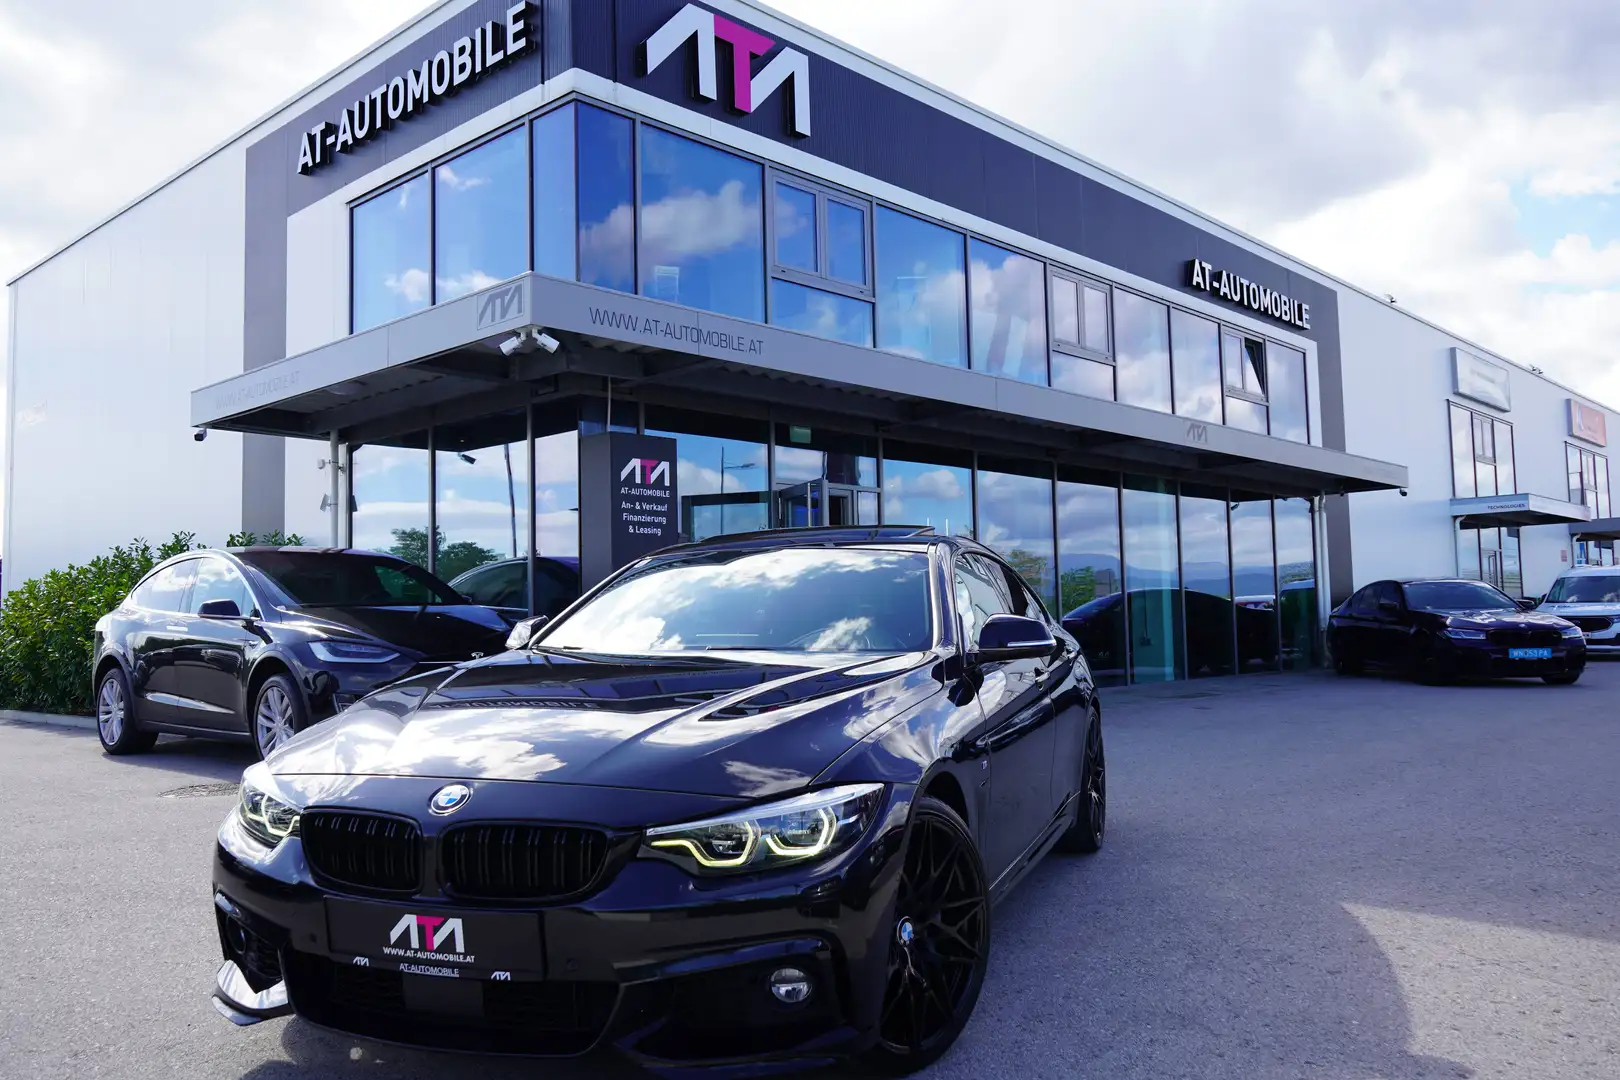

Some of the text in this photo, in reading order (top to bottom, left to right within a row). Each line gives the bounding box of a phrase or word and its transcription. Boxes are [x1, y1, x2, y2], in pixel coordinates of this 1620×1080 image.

[646, 3, 811, 137] ATA
[297, 1, 527, 174] AT-AUTOMOBILE
[1192, 258, 1311, 330] AT-AUTOMOBILE
[589, 307, 764, 355] WWW.AT-AUTOMOBILE.AT
[620, 487, 670, 498] AT-AUTOMOBILE
[621, 501, 668, 512] An- & Verkauf
[622, 512, 667, 525] Finanzierung
[628, 525, 661, 537] & Leasing
[389, 913, 465, 953] ATA
[383, 946, 475, 963] WWW.AT-AUTOMOBILE.AT
[399, 963, 460, 976] AT-AUTOMOBILE
